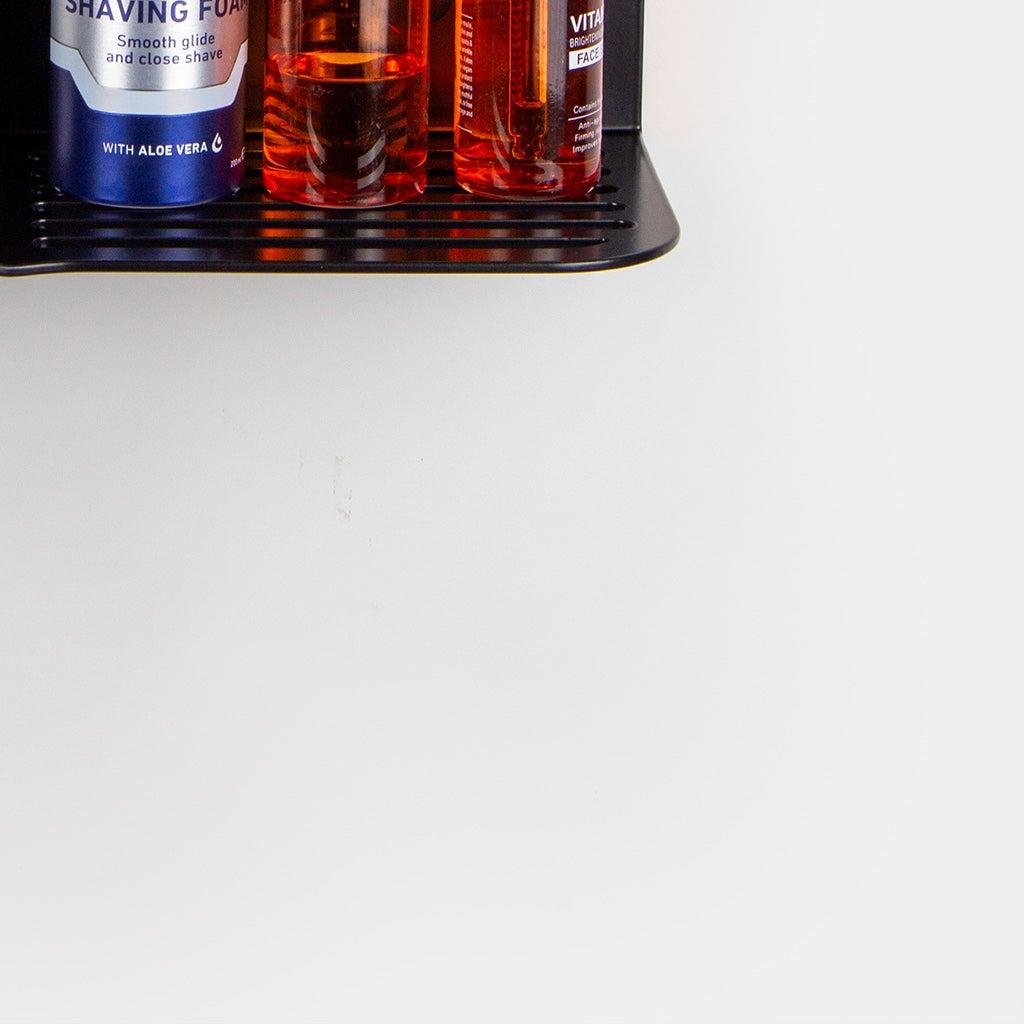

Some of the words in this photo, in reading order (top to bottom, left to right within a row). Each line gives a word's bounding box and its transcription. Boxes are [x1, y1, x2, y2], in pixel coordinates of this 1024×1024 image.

[117, 34, 177, 49] Smooth
[181, 33, 216, 51] glide
[106, 51, 133, 65] and
[139, 51, 180, 65] close
[185, 48, 223, 64] shave
[577, 47, 599, 65] FACE
[103, 141, 134, 156] WITH
[138, 144, 173, 156] ALOE
[176, 141, 208, 156] VERA
